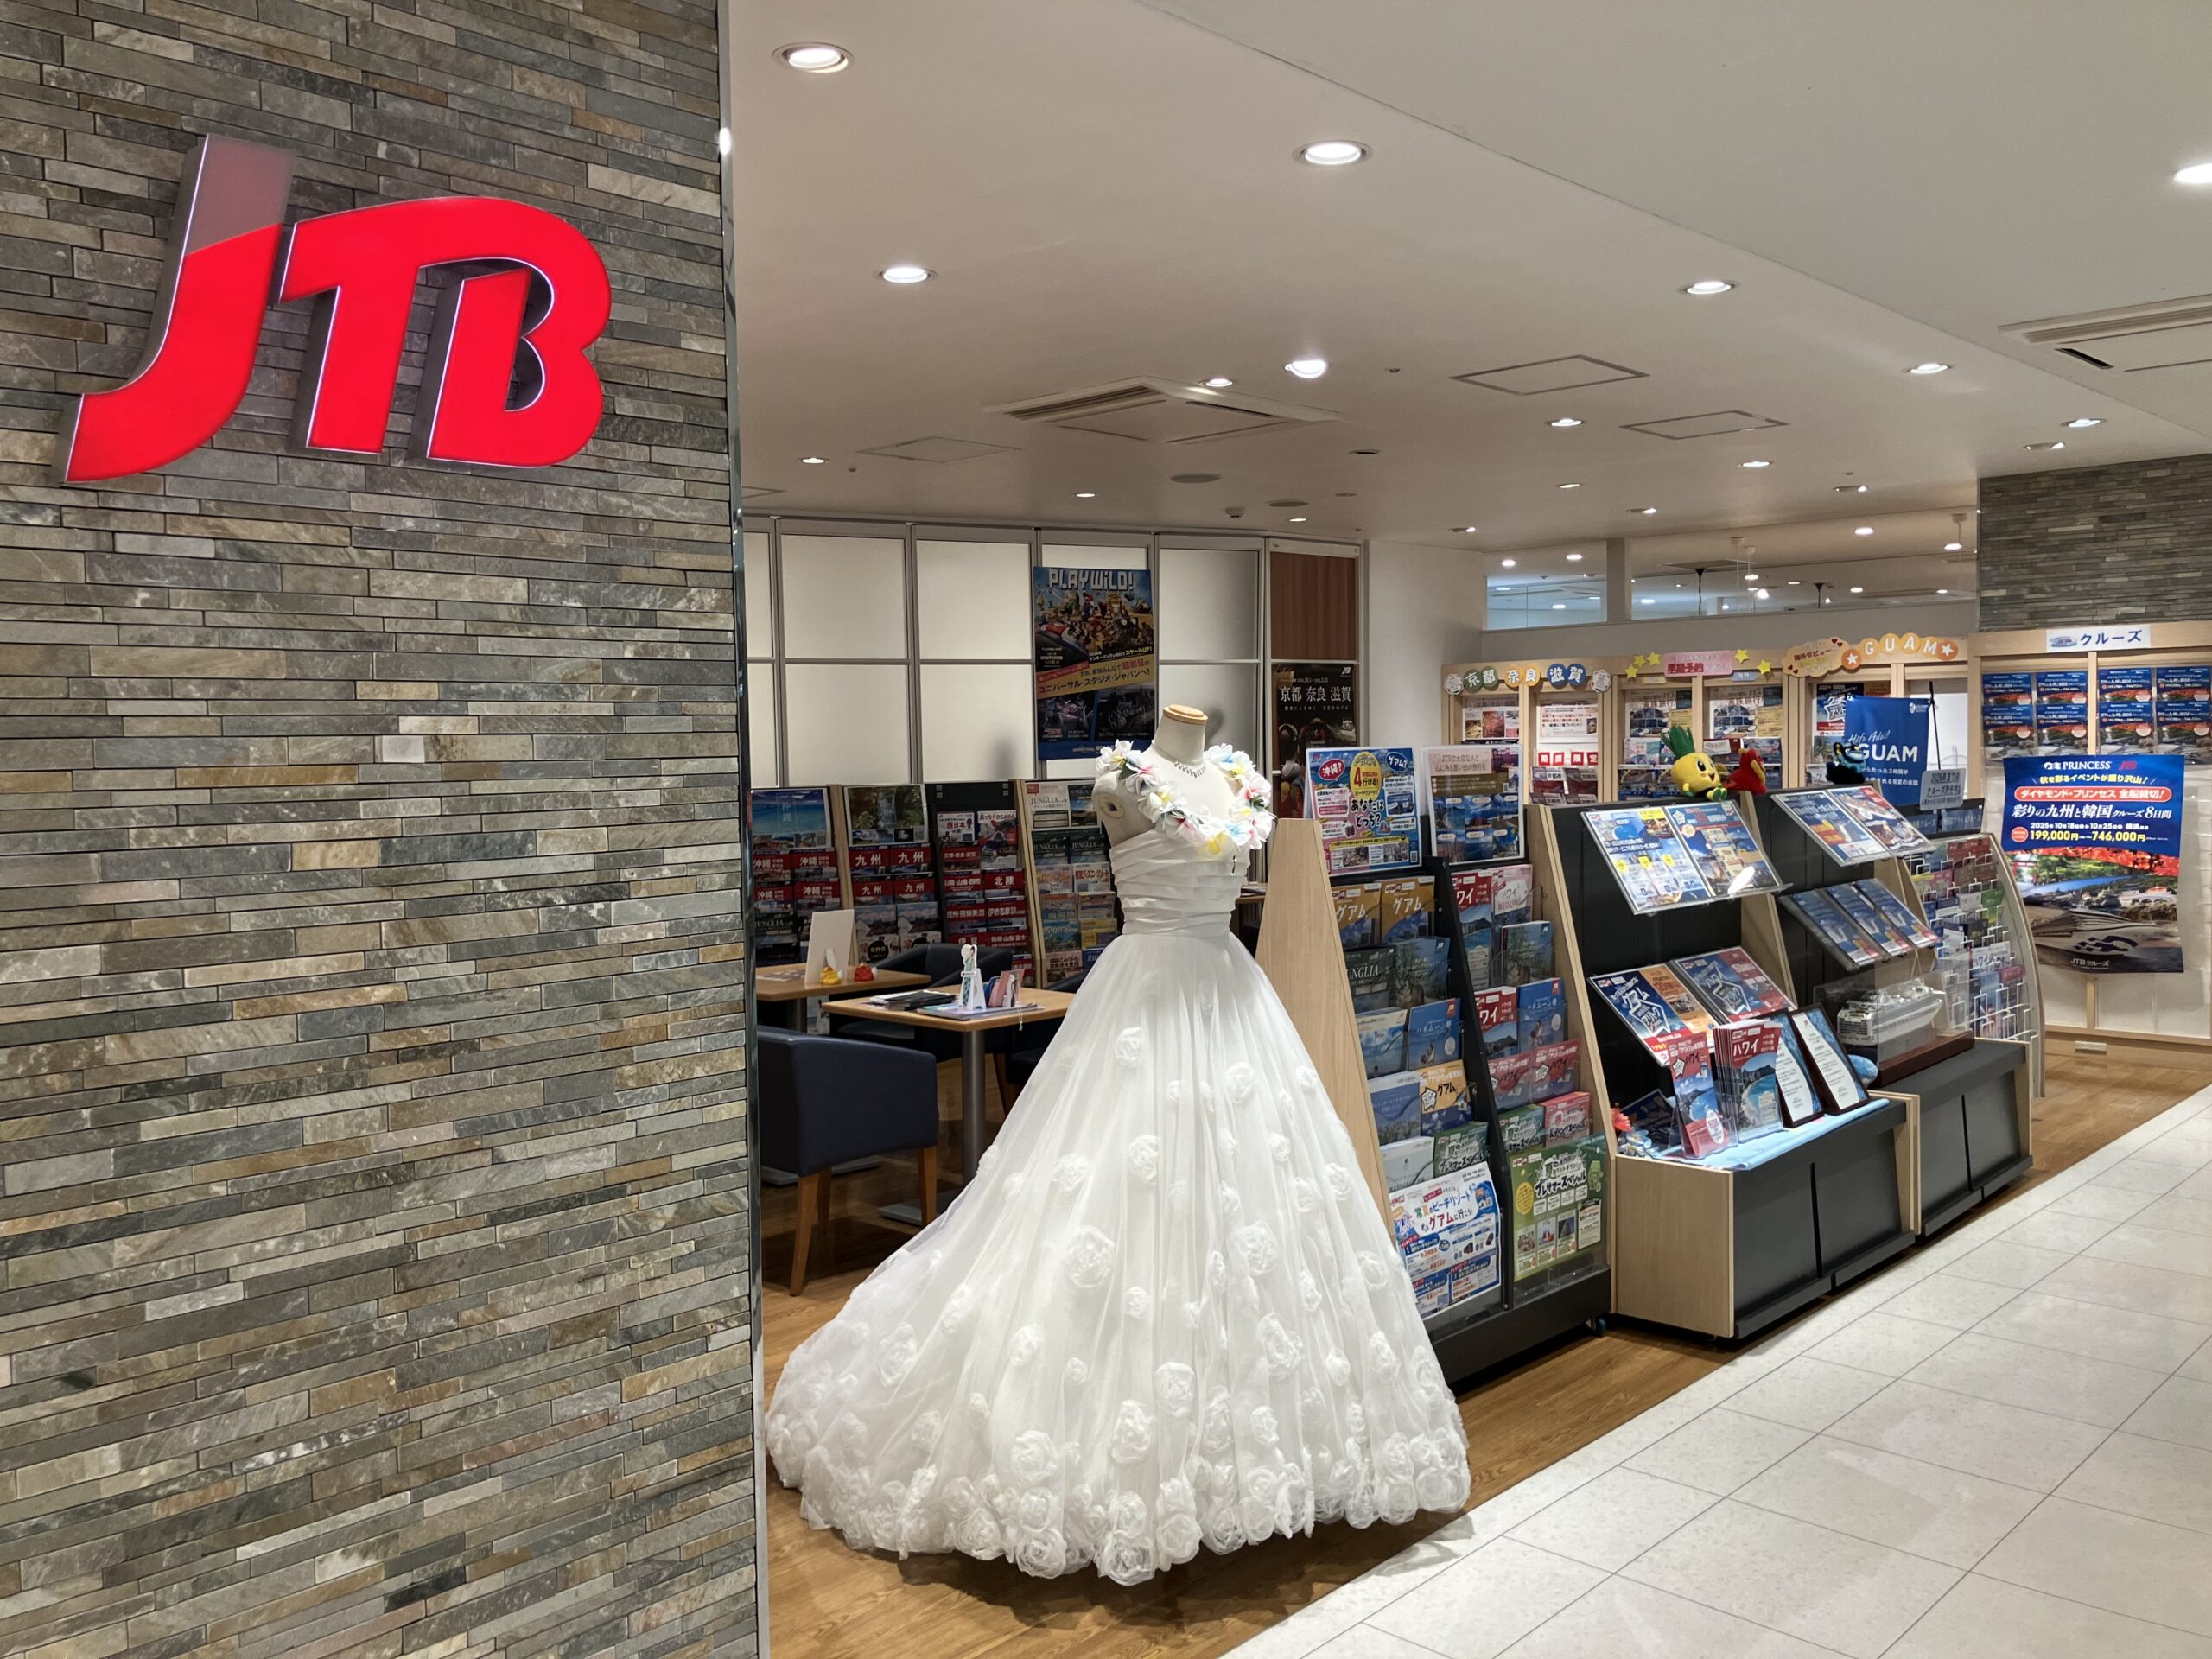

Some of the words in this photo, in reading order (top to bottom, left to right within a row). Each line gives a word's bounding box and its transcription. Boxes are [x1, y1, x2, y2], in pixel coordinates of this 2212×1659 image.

[65, 134, 612, 483] JTB
[1048, 569, 1090, 590] PLAY
[1865, 636, 1937, 655] GUAM
[2080, 629, 2143, 646] クルーズ
[1465, 669, 1495, 687] 京都
[1506, 669, 1536, 683] 奈良
[1549, 666, 1583, 683] 滋賀
[1280, 686, 1302, 702] 京都
[1306, 686, 1327, 702] 奈良
[1330, 686, 1351, 702] 滋賀
[1858, 743, 1918, 763] GUAM
[2063, 761, 2112, 770] PRINCESS
[1353, 766, 1362, 787] 4
[1030, 797, 1058, 805] JUNGLIA
[2020, 789, 2117, 798] ダイヤモンド・プリンセス
[1351, 798, 1385, 812] あなたは
[946, 821, 967, 830] 西日本
[1355, 813, 1382, 829] どっち?
[2030, 830, 2080, 841] 199,000円
[2091, 830, 2146, 842] 746,000円
[1071, 841, 1096, 849] JUNGLIA
[855, 853, 881, 867] 九州
[898, 850, 925, 864] 九州
[861, 885, 882, 895] 九州
[905, 882, 925, 893] 九州
[1455, 887, 1475, 906] ワイ
[1335, 903, 1368, 923] グアム
[1393, 896, 1425, 915] グアム
[2086, 959, 2110, 968] クルーズ
[1478, 1006, 1498, 1025] ワイ
[1733, 1038, 1759, 1057] ハワイ
[1436, 1082, 1457, 1097] グアム
[1535, 1170, 1587, 1198] プレサマースペシャル
